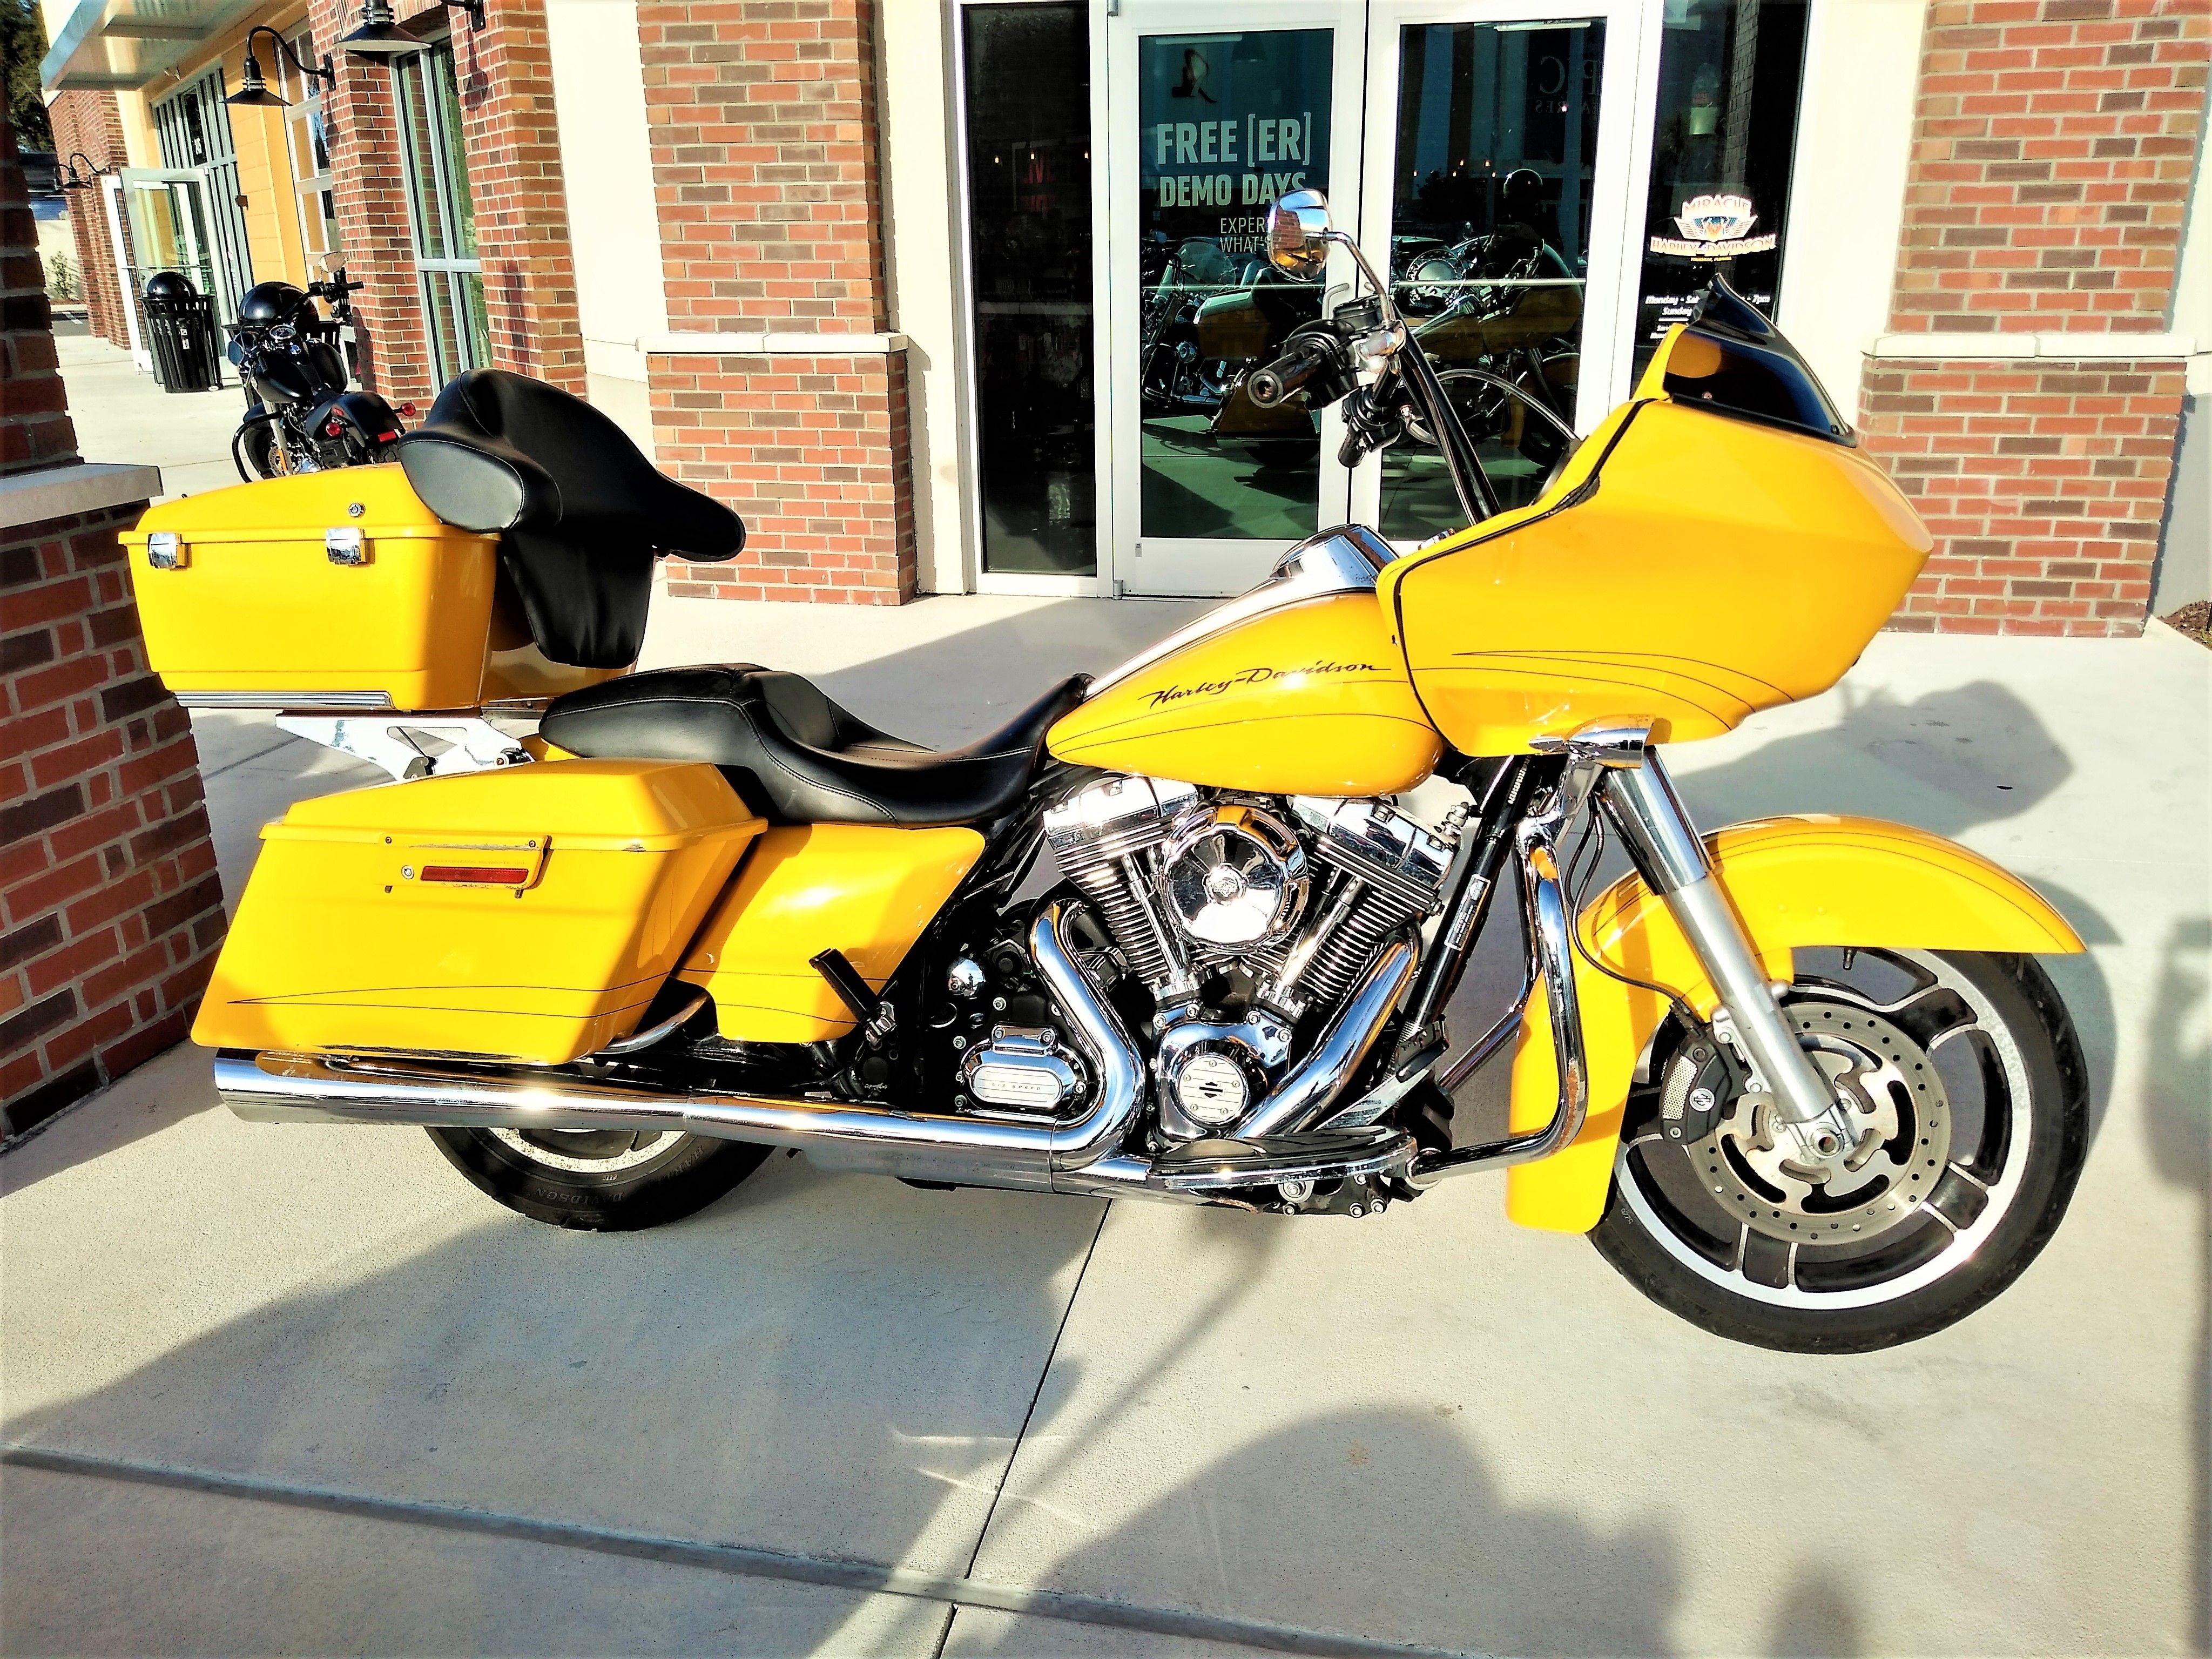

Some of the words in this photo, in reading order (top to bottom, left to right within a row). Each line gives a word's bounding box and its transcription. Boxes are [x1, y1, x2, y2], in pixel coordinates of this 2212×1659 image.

[1157, 120, 1238, 165] FREE
[1247, 111, 1312, 167] [ER]
[1159, 174, 1232, 207] DEMO
[1220, 217, 1267, 234] EXPER
[1645, 295, 1679, 306] Monday
[1752, 294, 1771, 305] 7pm
[1662, 307, 1692, 316] Sunday
[1137, 660, 1392, 710] Harley-Davidson
